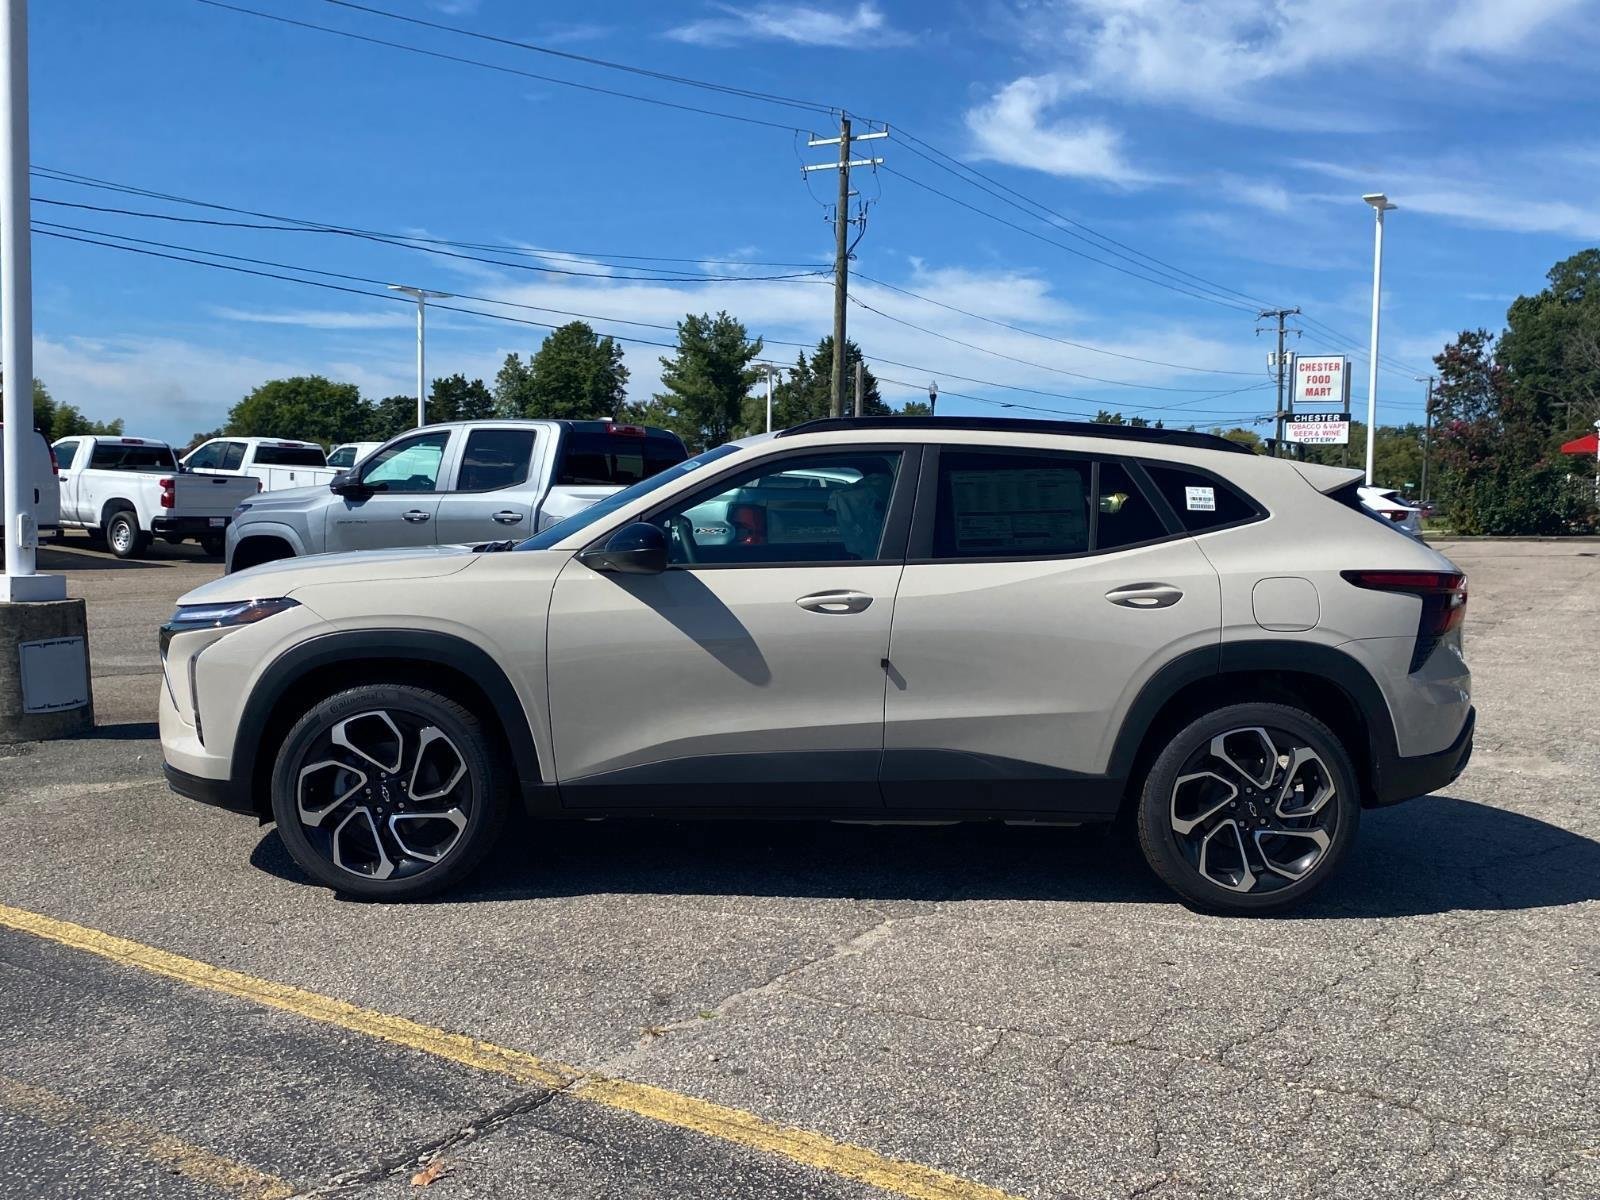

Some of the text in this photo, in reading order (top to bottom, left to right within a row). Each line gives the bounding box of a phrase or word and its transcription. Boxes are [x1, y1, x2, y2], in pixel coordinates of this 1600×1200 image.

[1299, 362, 1341, 372] CHESTER
[1306, 375, 1331, 384] FOOD
[1305, 387, 1332, 396] MART
[1294, 414, 1340, 422] CHESTER
